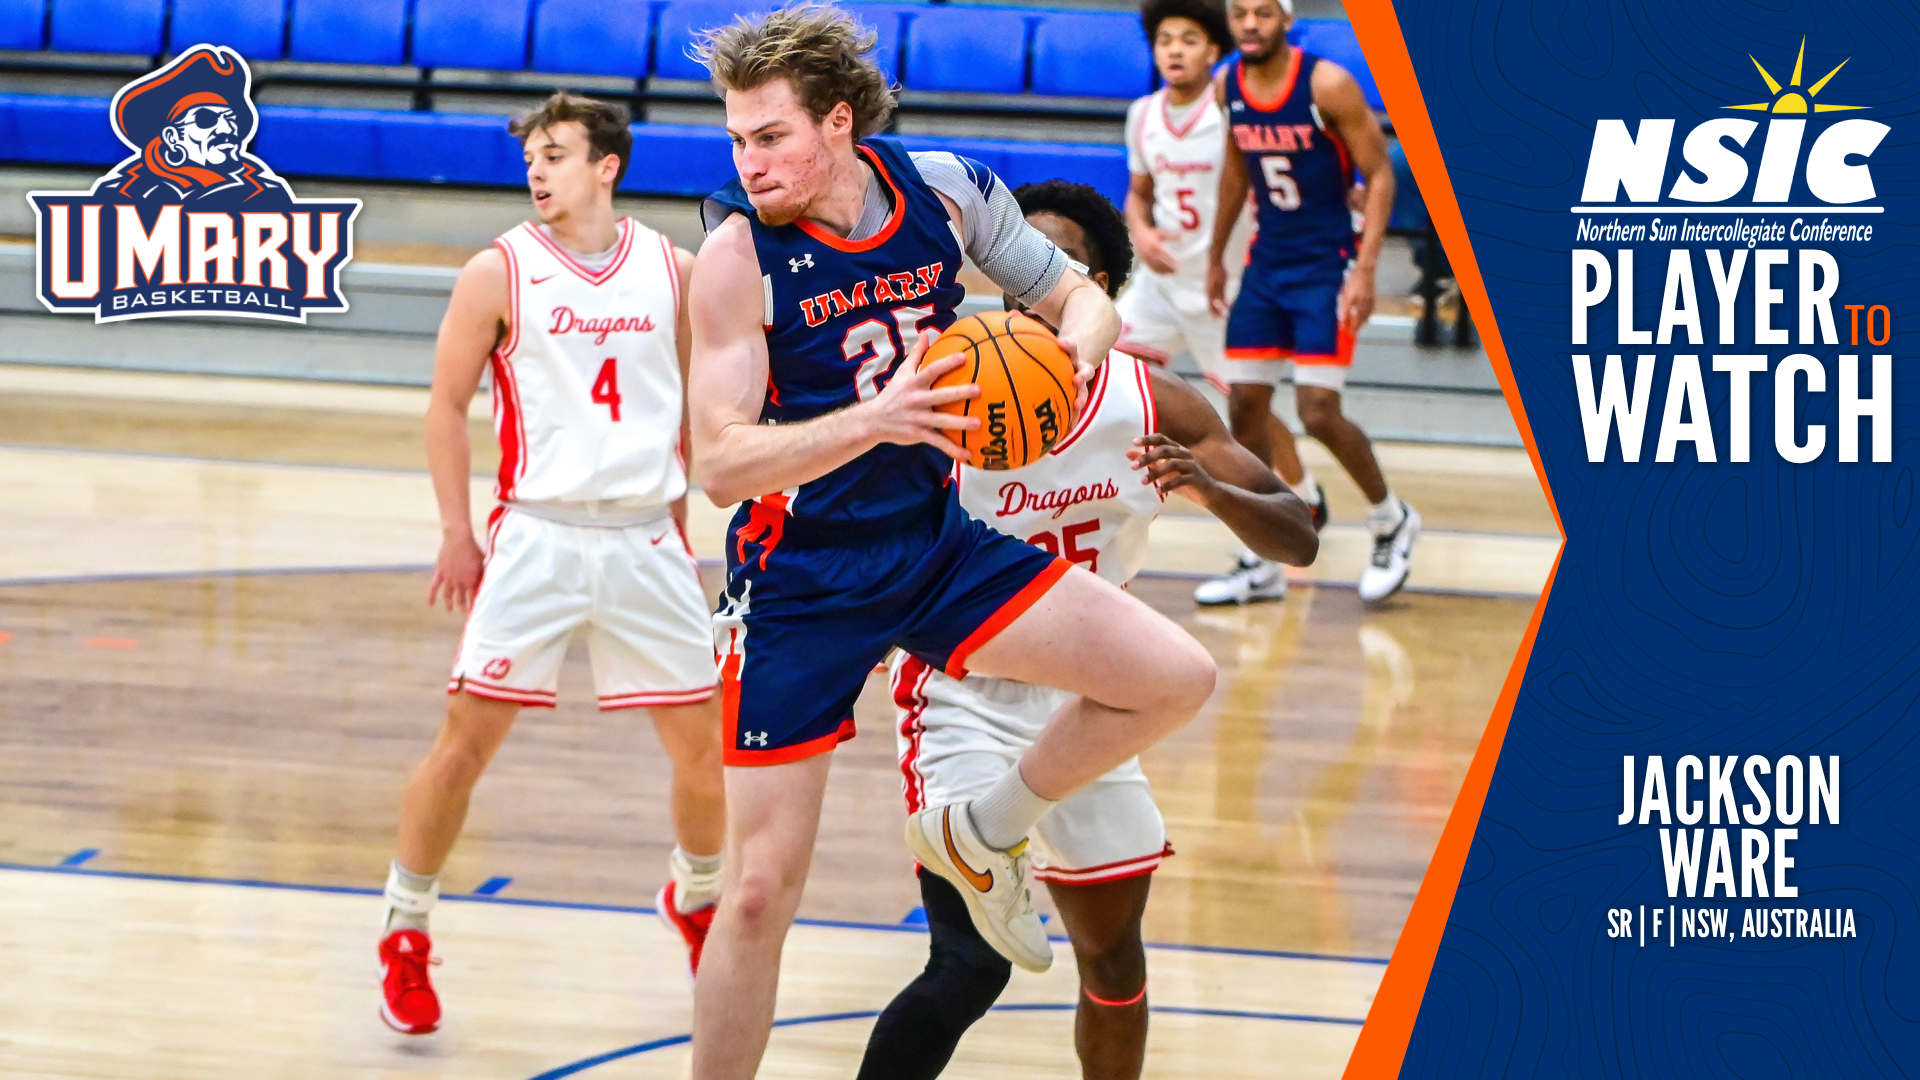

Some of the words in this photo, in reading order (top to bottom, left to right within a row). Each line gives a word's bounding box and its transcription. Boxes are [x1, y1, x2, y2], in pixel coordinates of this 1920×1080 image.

[1260, 155, 1301, 211] 5
[1176, 188, 1199, 231] 5
[800, 261, 944, 328] UMARY
[548, 306, 656, 346] Dragons
[590, 357, 622, 422] 4
[995, 477, 1119, 519] Dragons
